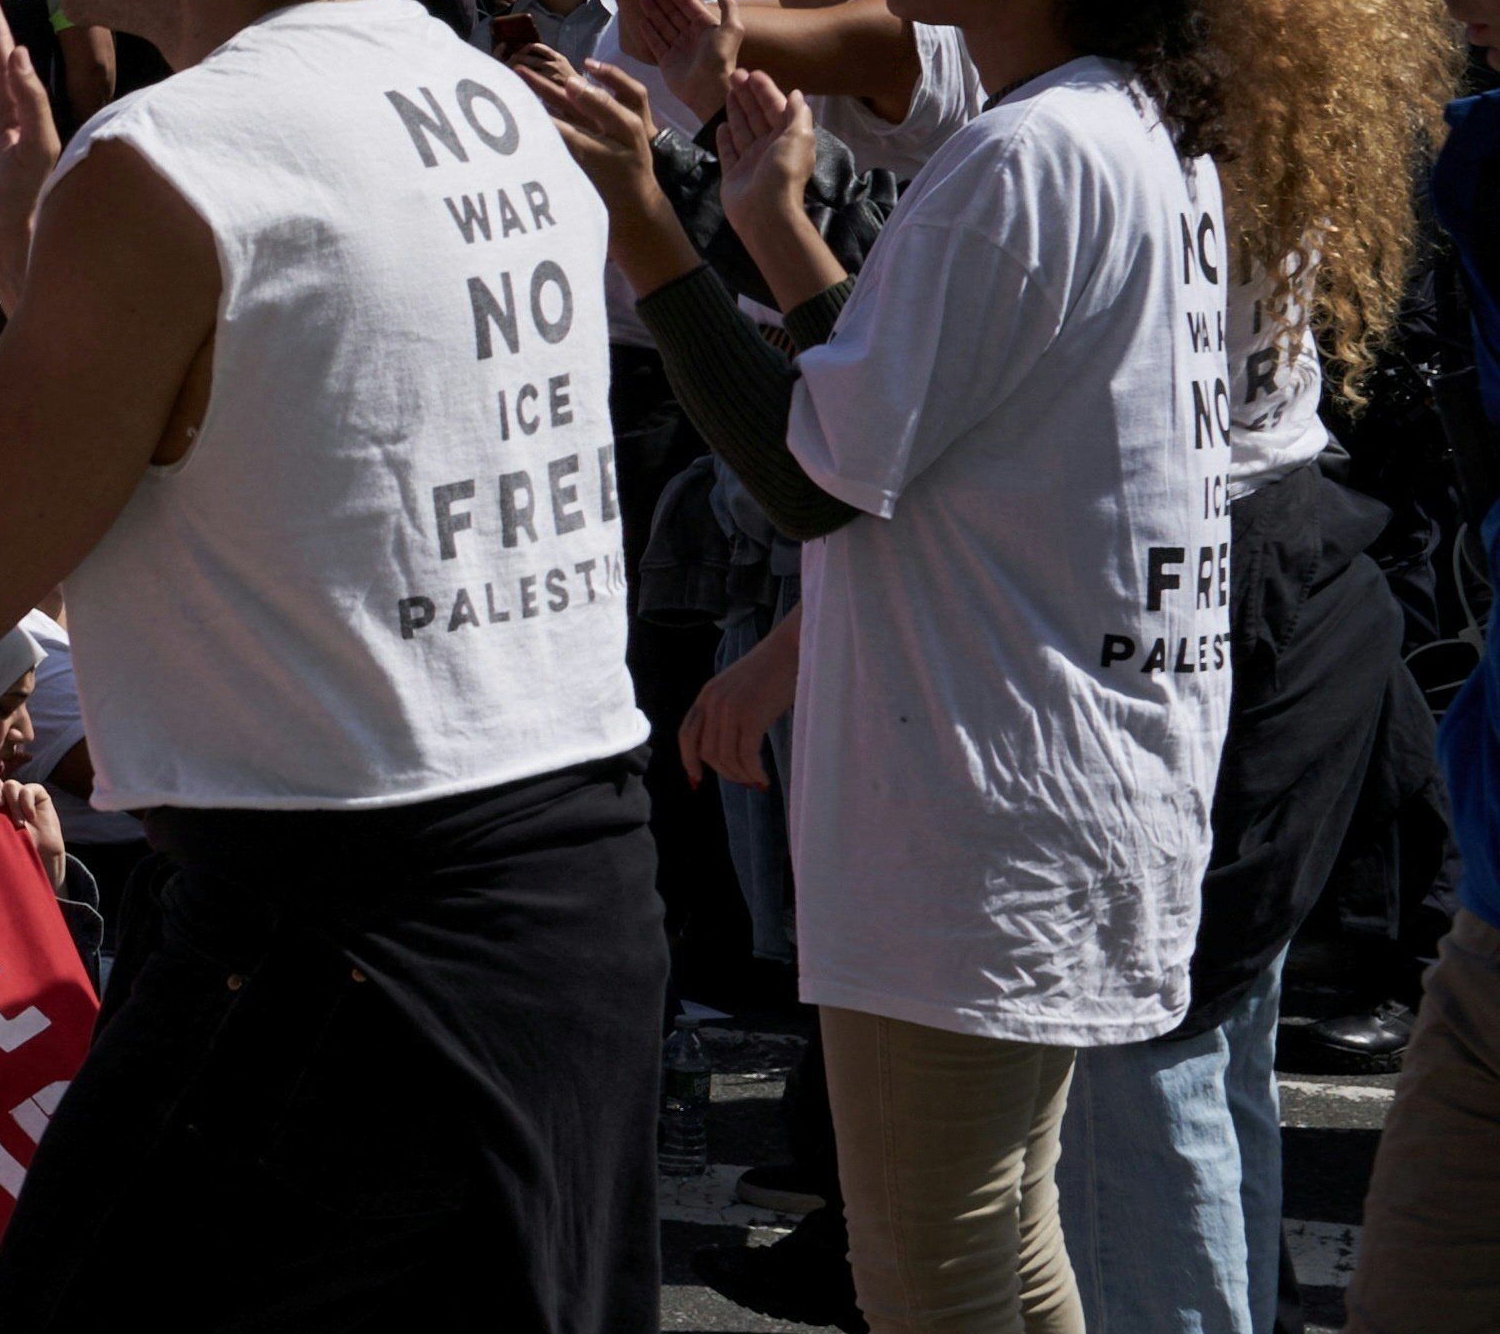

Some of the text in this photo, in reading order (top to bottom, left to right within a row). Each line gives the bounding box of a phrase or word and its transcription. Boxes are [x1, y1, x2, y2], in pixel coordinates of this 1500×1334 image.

[385, 76, 521, 171] NO
[443, 179, 557, 245] WAR
[466, 257, 576, 361] NO
[498, 372, 575, 442] ICE
[433, 442, 618, 561] FREE
[398, 551, 625, 641] PALESTI
[1146, 545, 1231, 613] FRE
